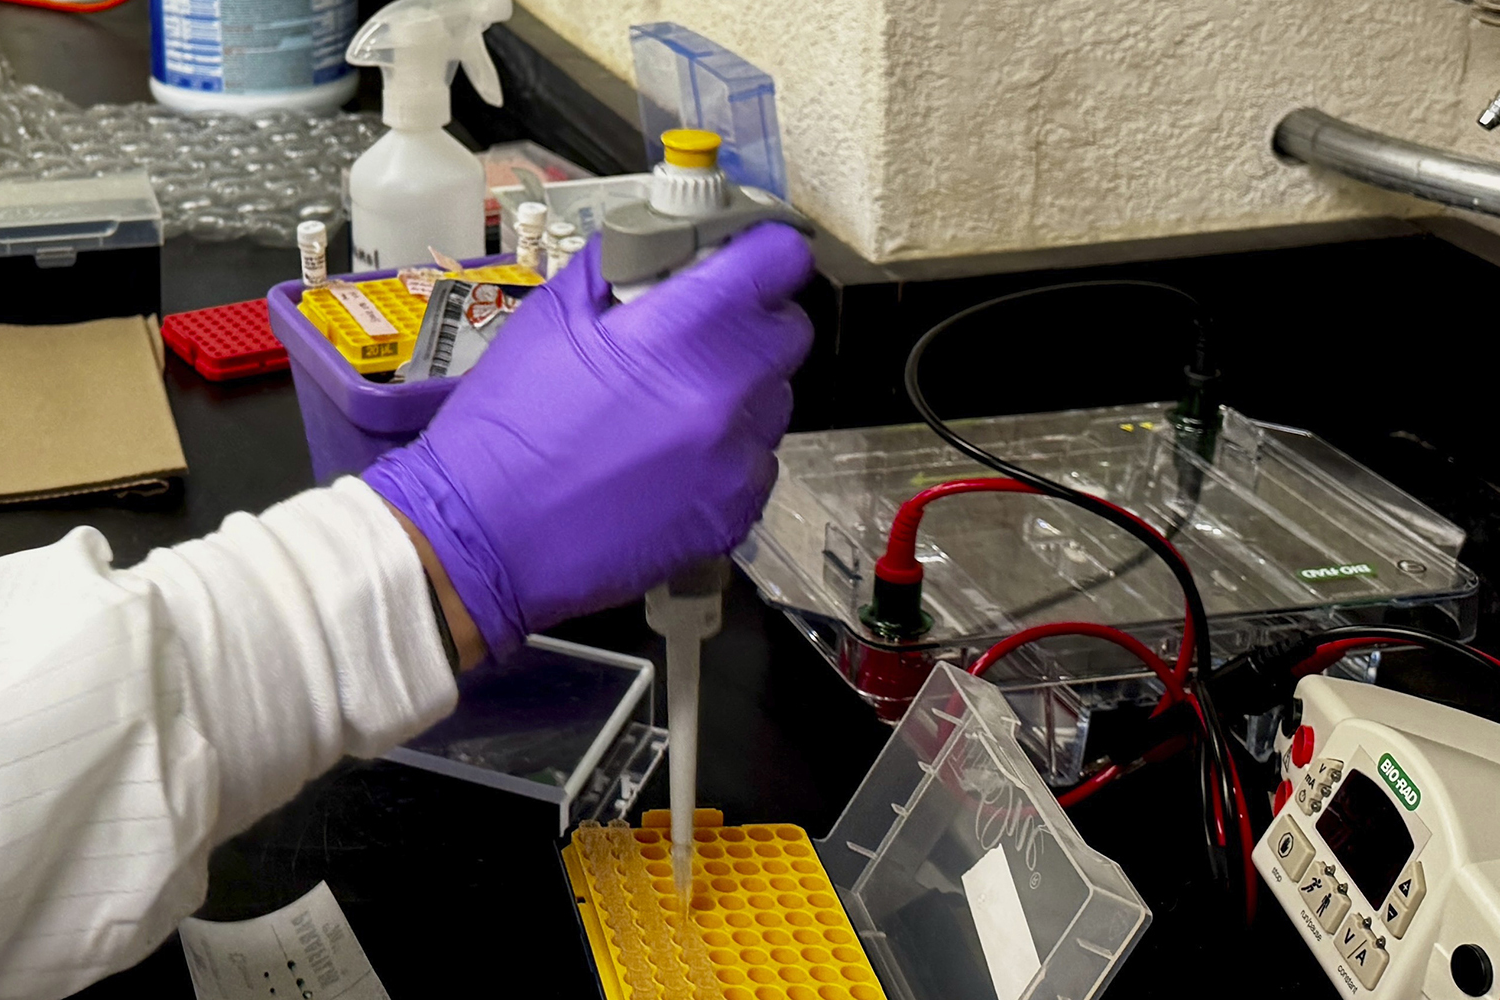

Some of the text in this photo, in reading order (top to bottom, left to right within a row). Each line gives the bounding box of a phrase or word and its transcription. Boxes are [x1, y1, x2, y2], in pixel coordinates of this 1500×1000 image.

[1380, 758, 1418, 806] BIO-RAD
[1271, 866, 1283, 883] stop
[1300, 909, 1323, 942] run/pause
[1337, 964, 1359, 995] constant
